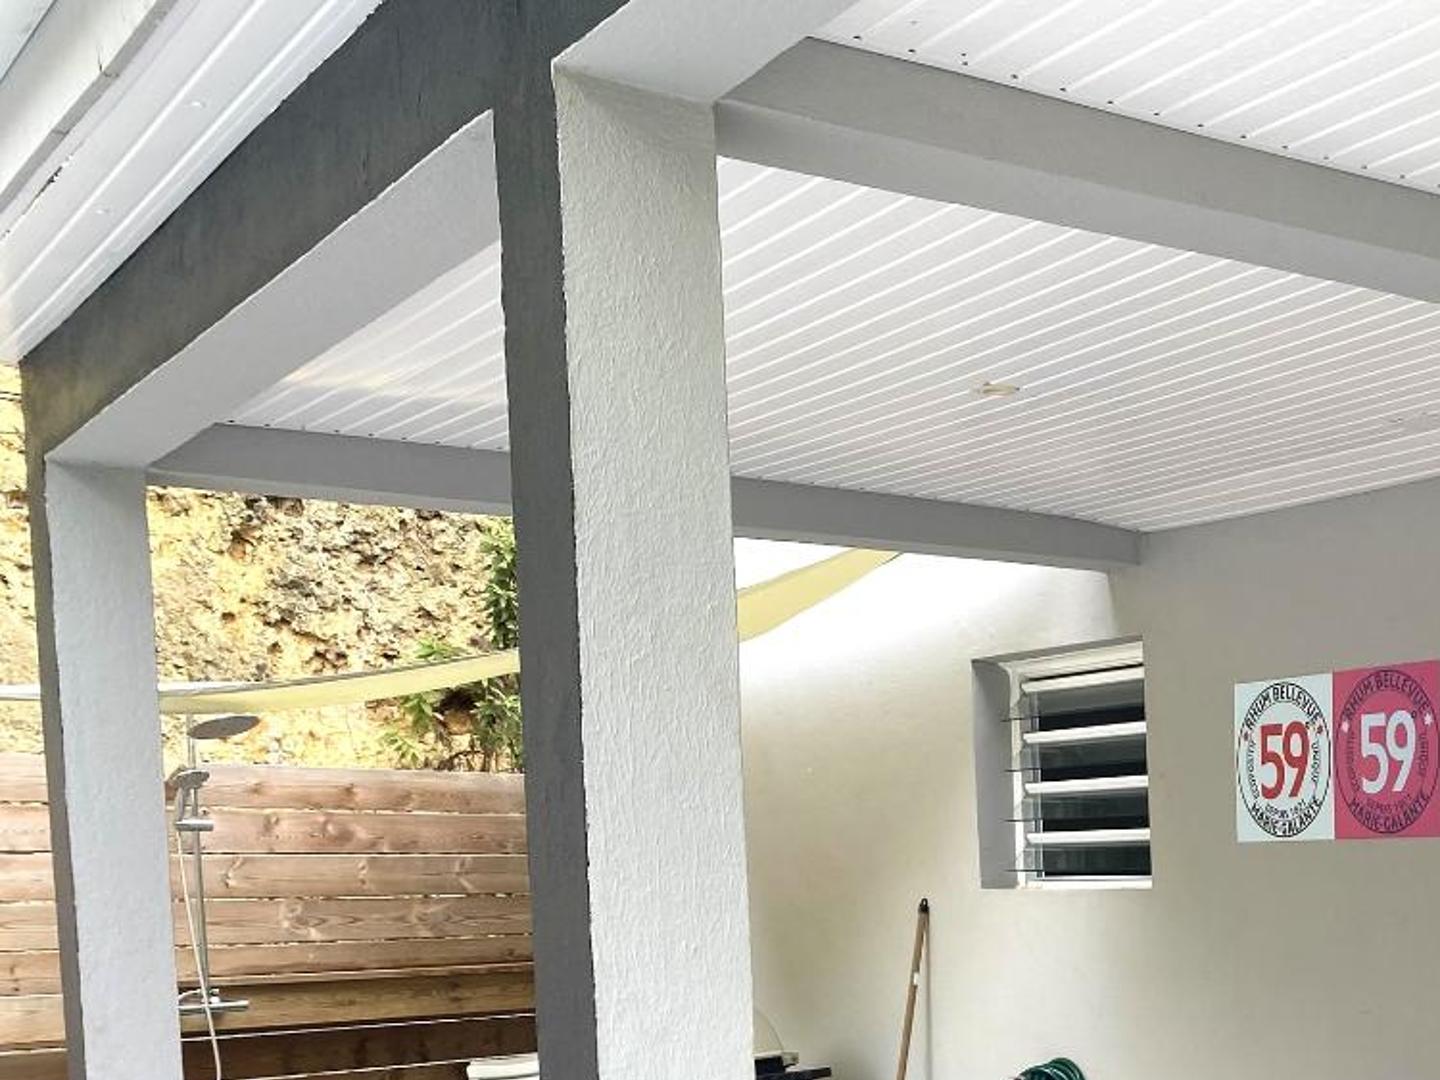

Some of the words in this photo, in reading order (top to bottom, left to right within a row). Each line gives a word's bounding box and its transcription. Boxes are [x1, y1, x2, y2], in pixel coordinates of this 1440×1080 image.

[1244, 691, 1271, 730] RHUM
[1272, 684, 1322, 724] BELLEVUE
[1345, 679, 1373, 720] RHUM
[1375, 672, 1430, 715] BELLEVUE
[1350, 790, 1429, 831] MARIE-GALANTE
